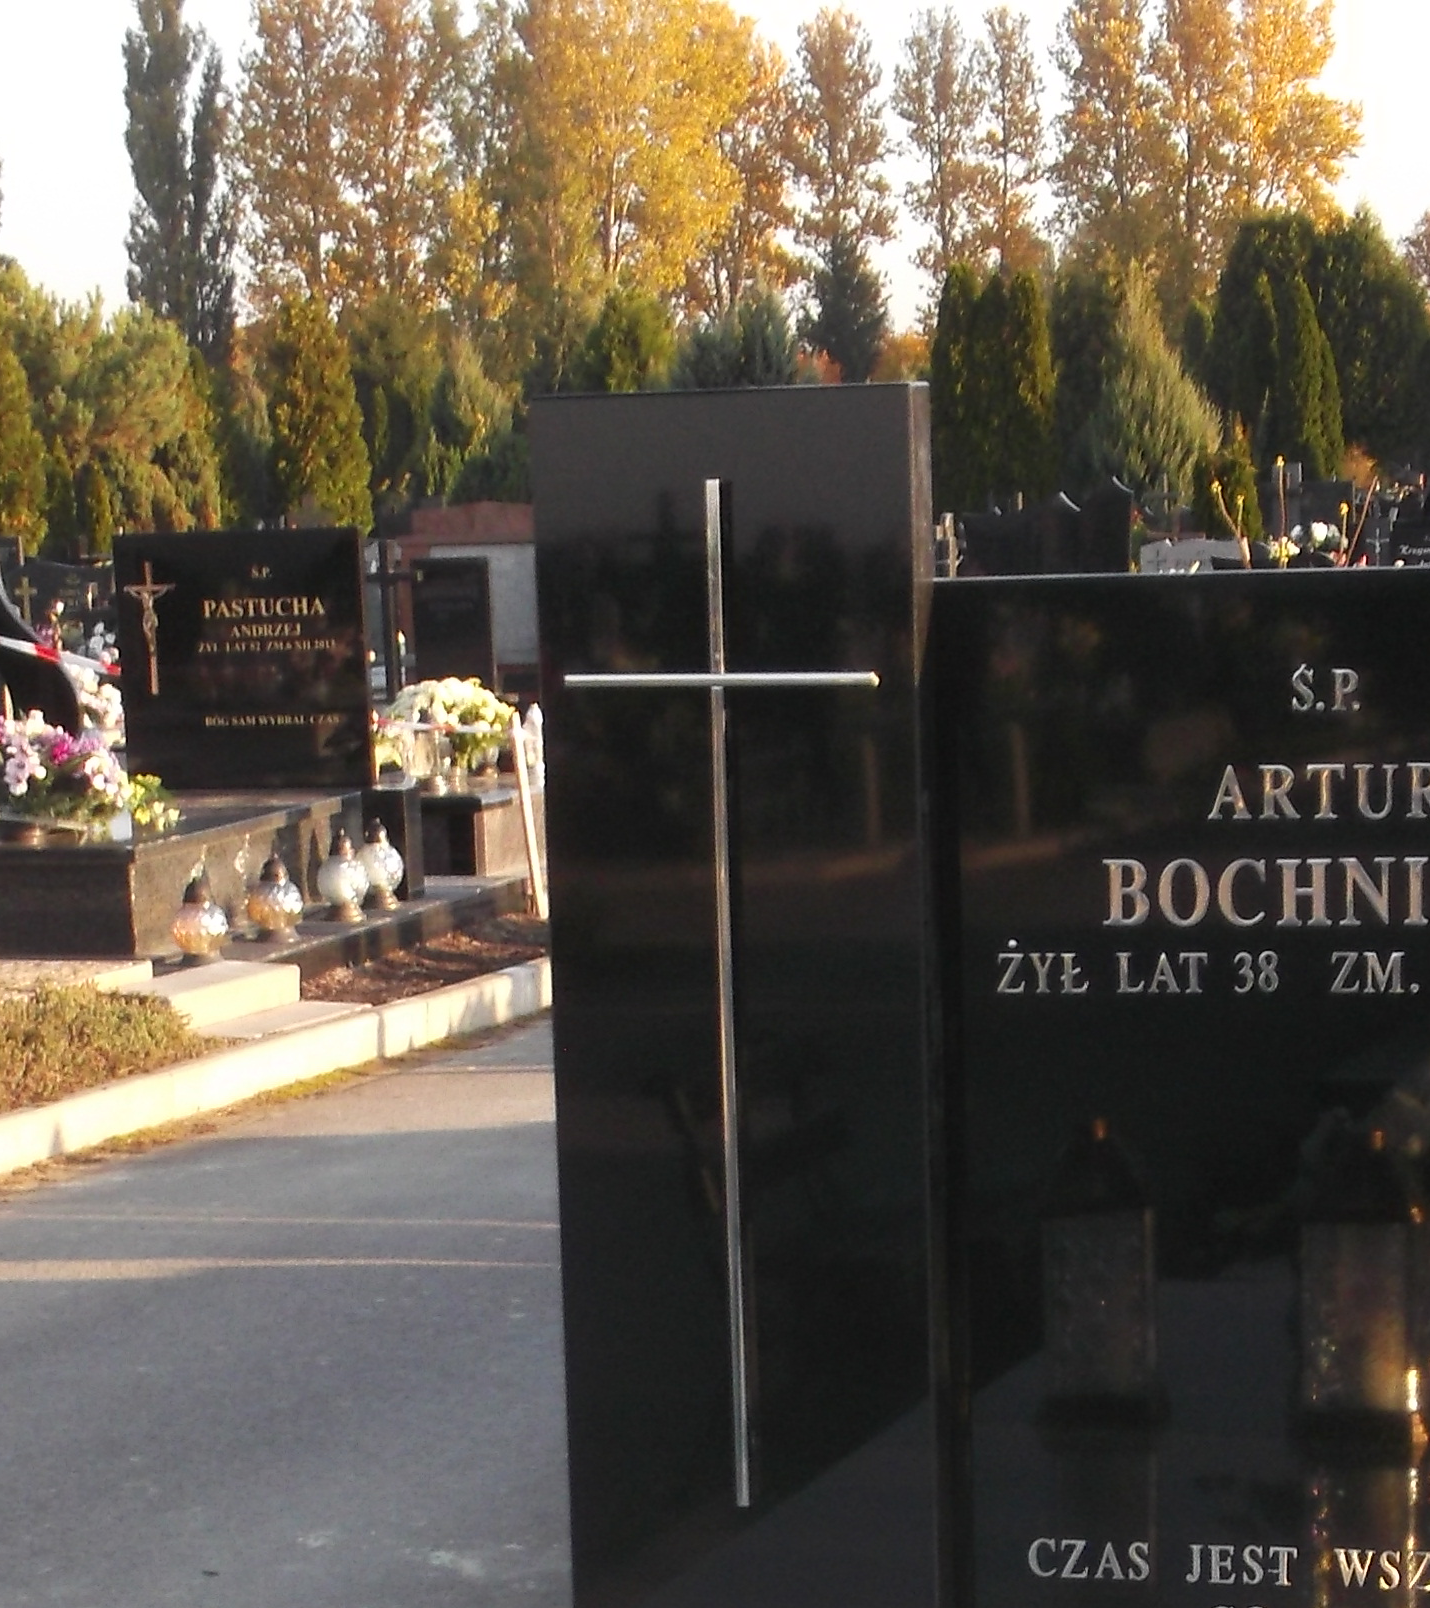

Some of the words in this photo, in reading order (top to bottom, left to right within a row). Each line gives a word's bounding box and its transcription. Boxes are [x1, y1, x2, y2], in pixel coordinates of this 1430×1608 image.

[203, 596, 326, 619] PASTUCHA
[231, 622, 302, 638] ANDRZEJ
[1291, 663, 1361, 712] Ś.P.
[997, 939, 1090, 993] ŻYŁ
[1116, 951, 1208, 993] LAT
[1233, 950, 1280, 993] 38
[1331, 951, 1420, 993] ZM.
[1028, 1538, 1151, 1581] CZAS
[1186, 1544, 1298, 1587] JEST
